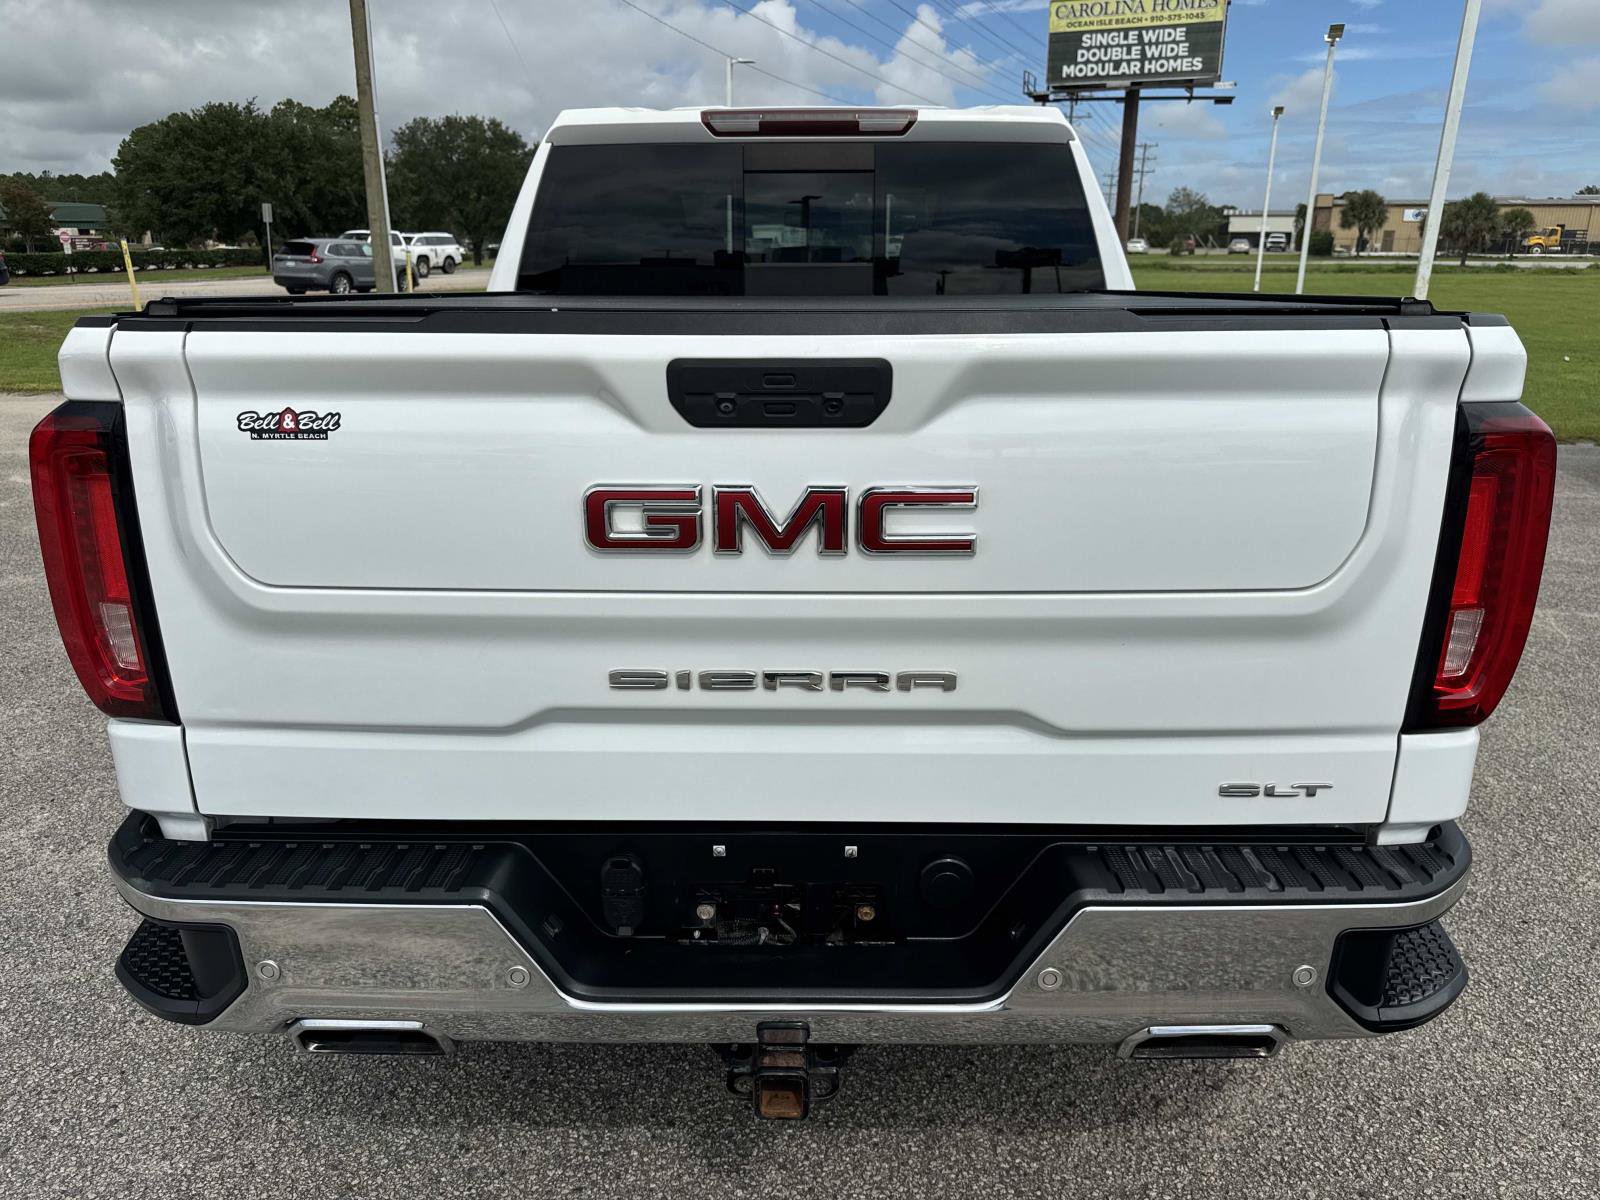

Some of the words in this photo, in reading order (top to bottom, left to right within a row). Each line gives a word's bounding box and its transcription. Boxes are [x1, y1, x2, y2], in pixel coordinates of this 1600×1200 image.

[1055, 0, 1145, 19] CAROLINA
[1152, 0, 1218, 12] HOMES
[1066, 20, 1095, 29] OCEAN
[1096, 18, 1113, 26] ISLE
[1115, 16, 1143, 25] BEACH
[1081, 30, 1138, 47] SINGLE
[1142, 27, 1187, 44] WIDE
[1076, 46, 1141, 63] DOUBLE
[1144, 43, 1189, 59] WIDE
[1061, 62, 1140, 79] MODULAR
[1143, 57, 1203, 74] HOMES
[238, 411, 280, 430] Bell
[282, 413, 295, 429] &
[297, 411, 341, 430] Bell
[583, 482, 980, 556] GMC
[608, 668, 958, 692] SIERRA
[1219, 782, 1333, 798] SLT
